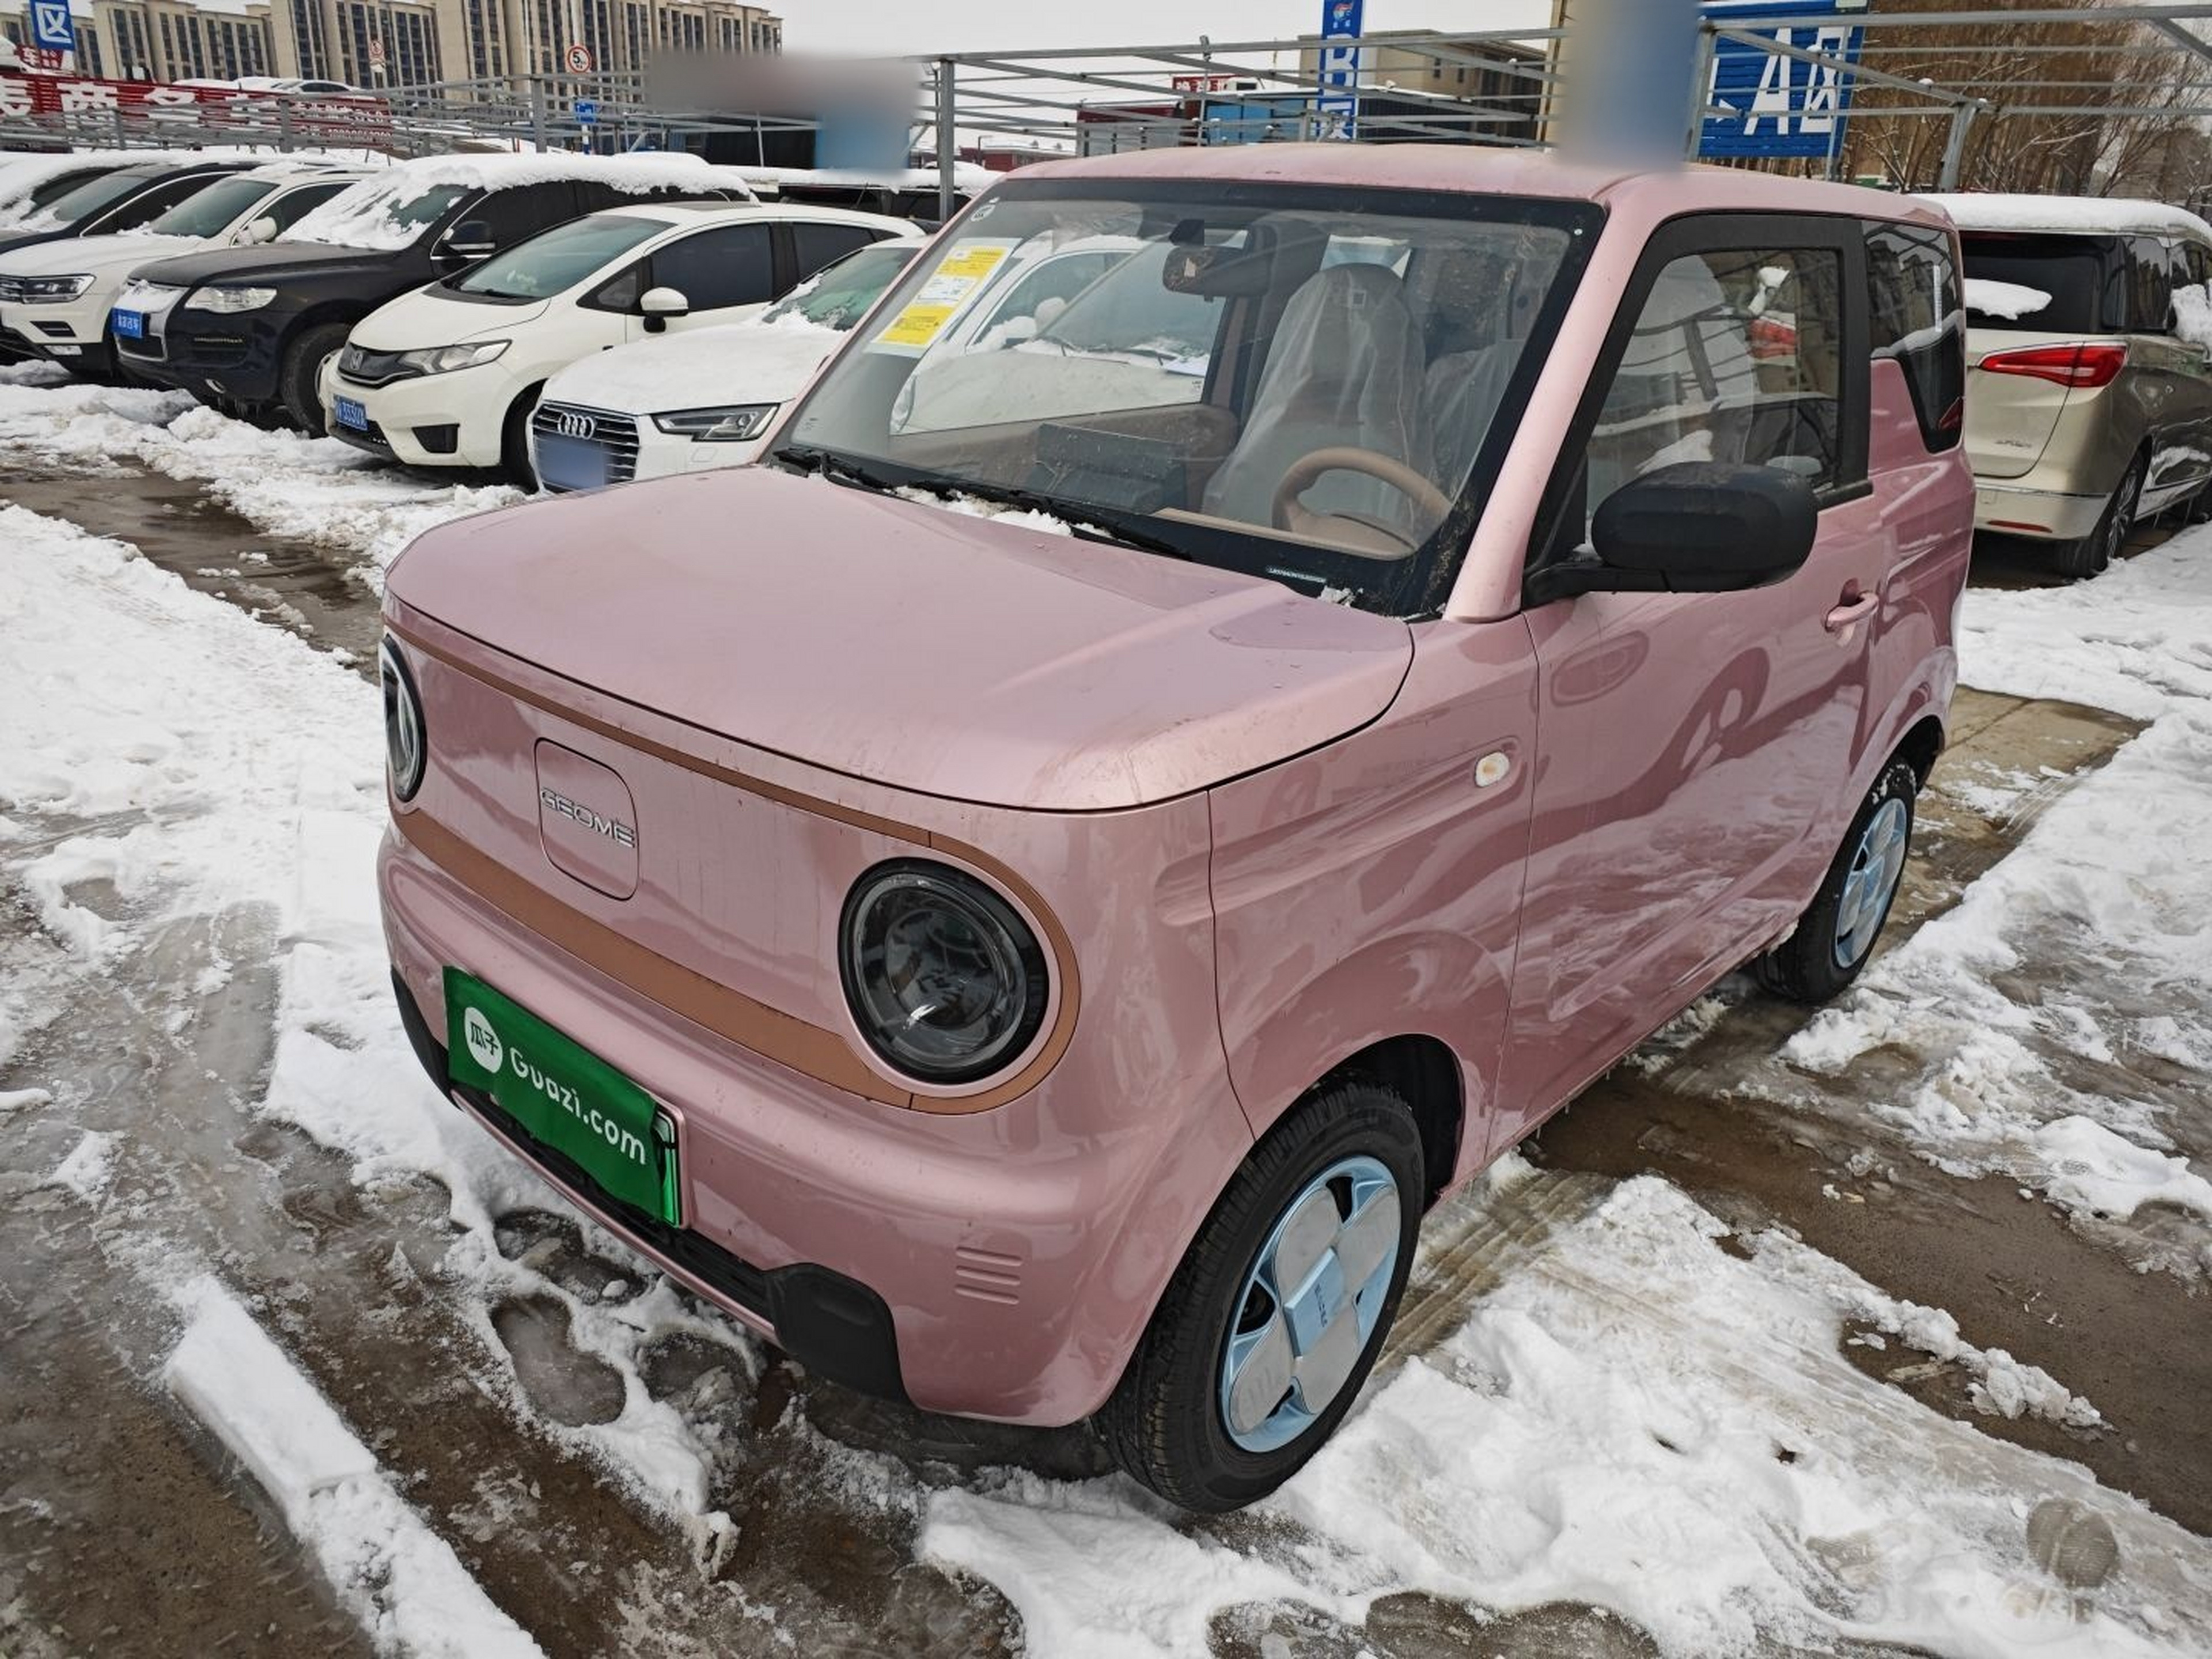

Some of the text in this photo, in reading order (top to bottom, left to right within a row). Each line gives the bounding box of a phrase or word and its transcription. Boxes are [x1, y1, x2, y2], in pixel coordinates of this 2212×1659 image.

[35, 2, 73, 44] 区
[540, 787, 635, 848] GEOME
[470, 1021, 646, 1165] 瓜子 Guazi.com
